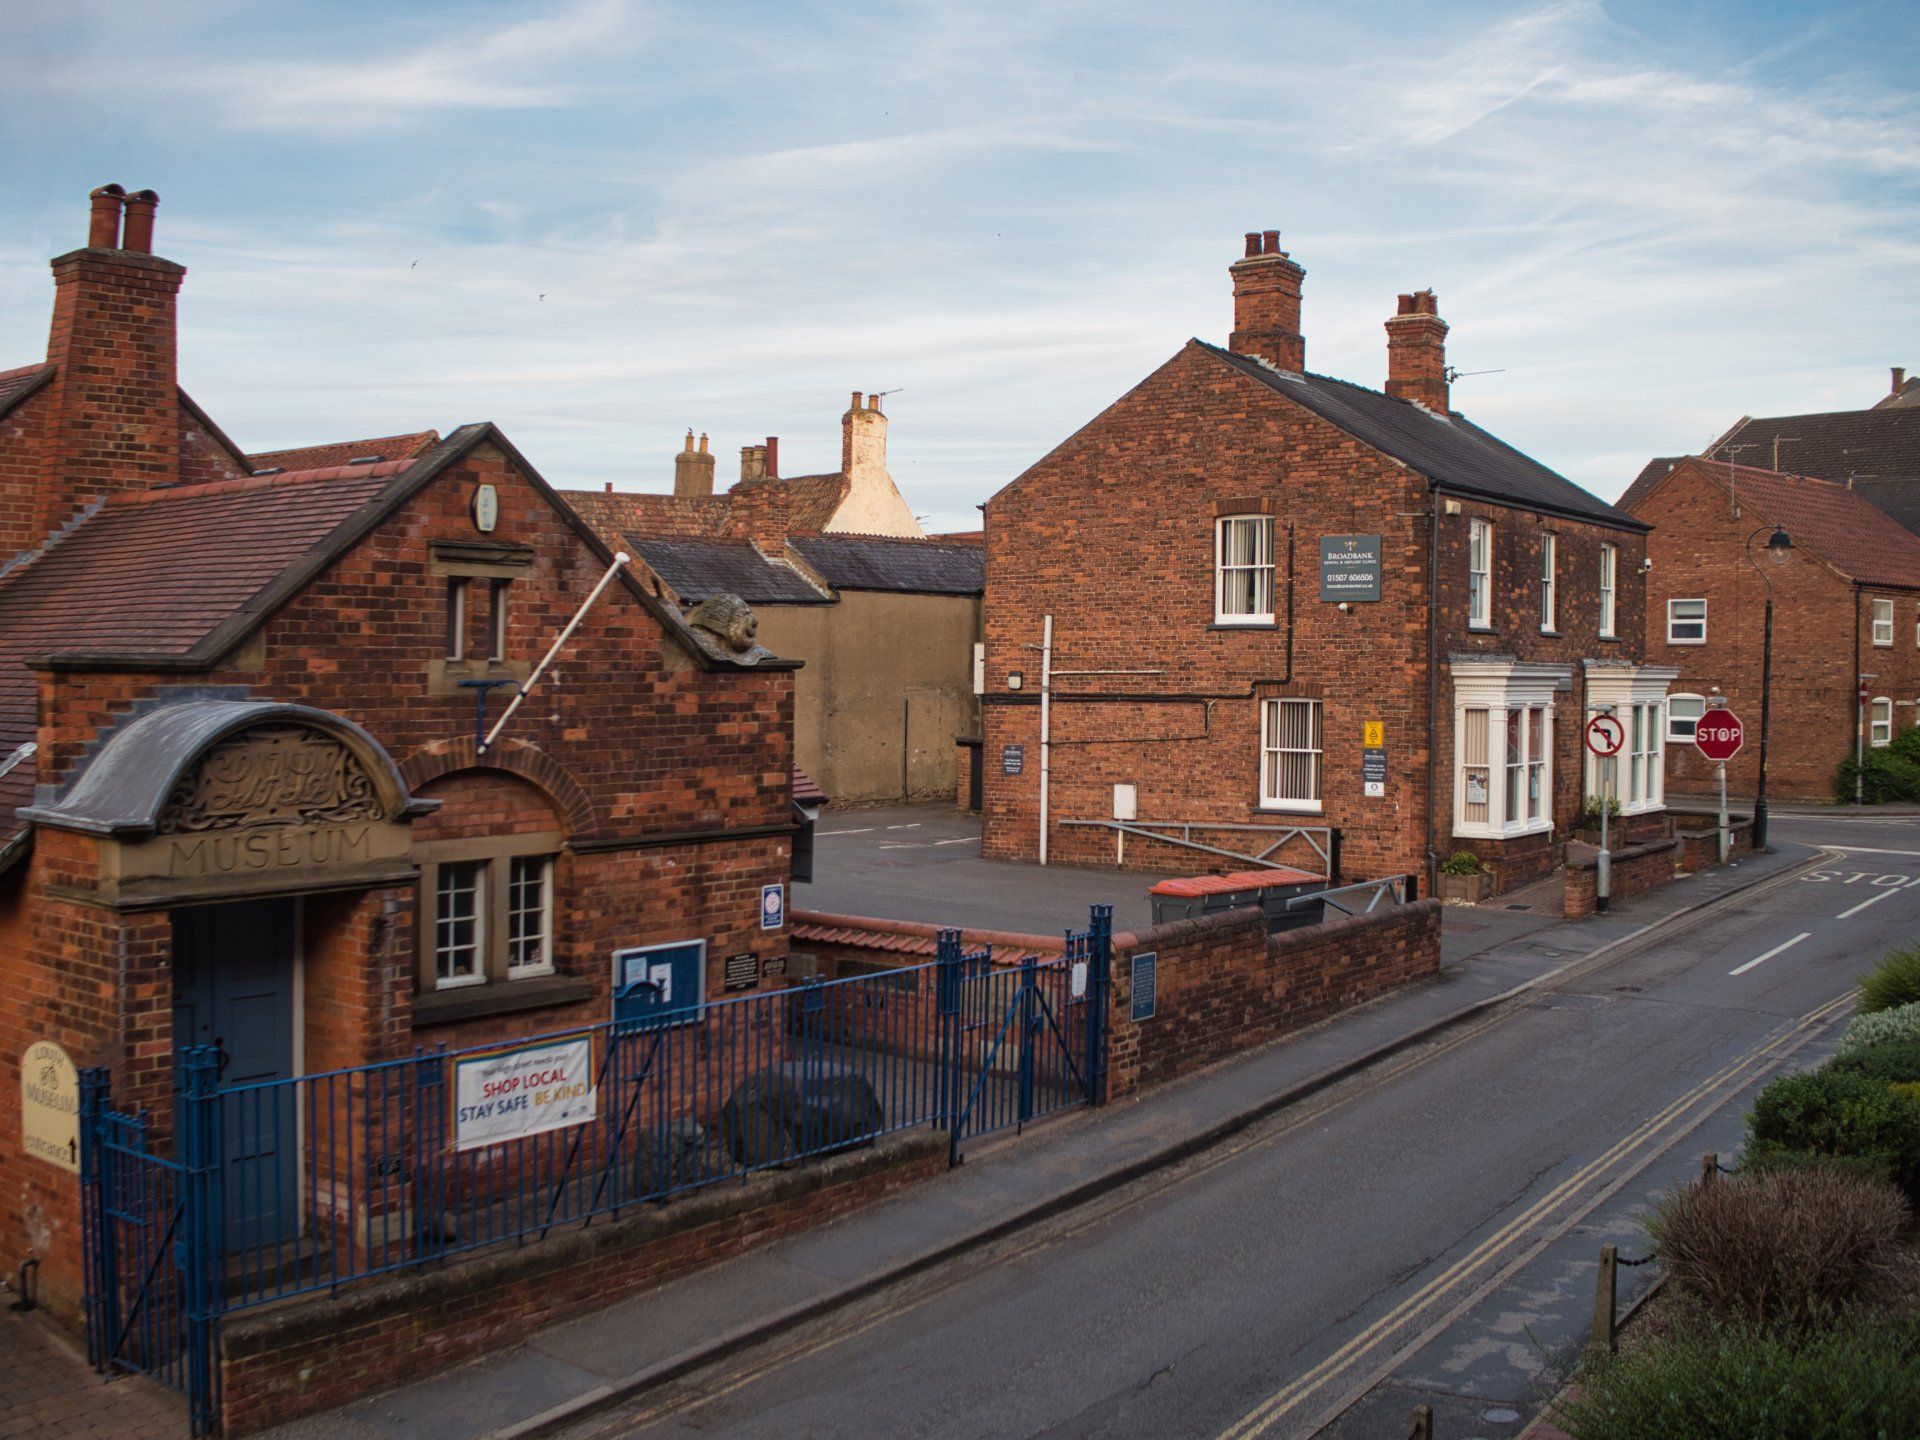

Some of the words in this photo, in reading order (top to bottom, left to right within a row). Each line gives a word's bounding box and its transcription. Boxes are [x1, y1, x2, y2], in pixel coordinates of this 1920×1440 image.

[1698, 727, 1741, 742] STOP
[168, 826, 372, 877] MUSEUM
[27, 1083, 74, 1112] MUSEUM
[483, 1076, 519, 1099] SHOP
[522, 1067, 567, 1089] LOCAL
[460, 1102, 495, 1122] STAY
[497, 1095, 528, 1116] SAFE
[534, 1090, 550, 1106] BE
[553, 1082, 586, 1103] KIND
